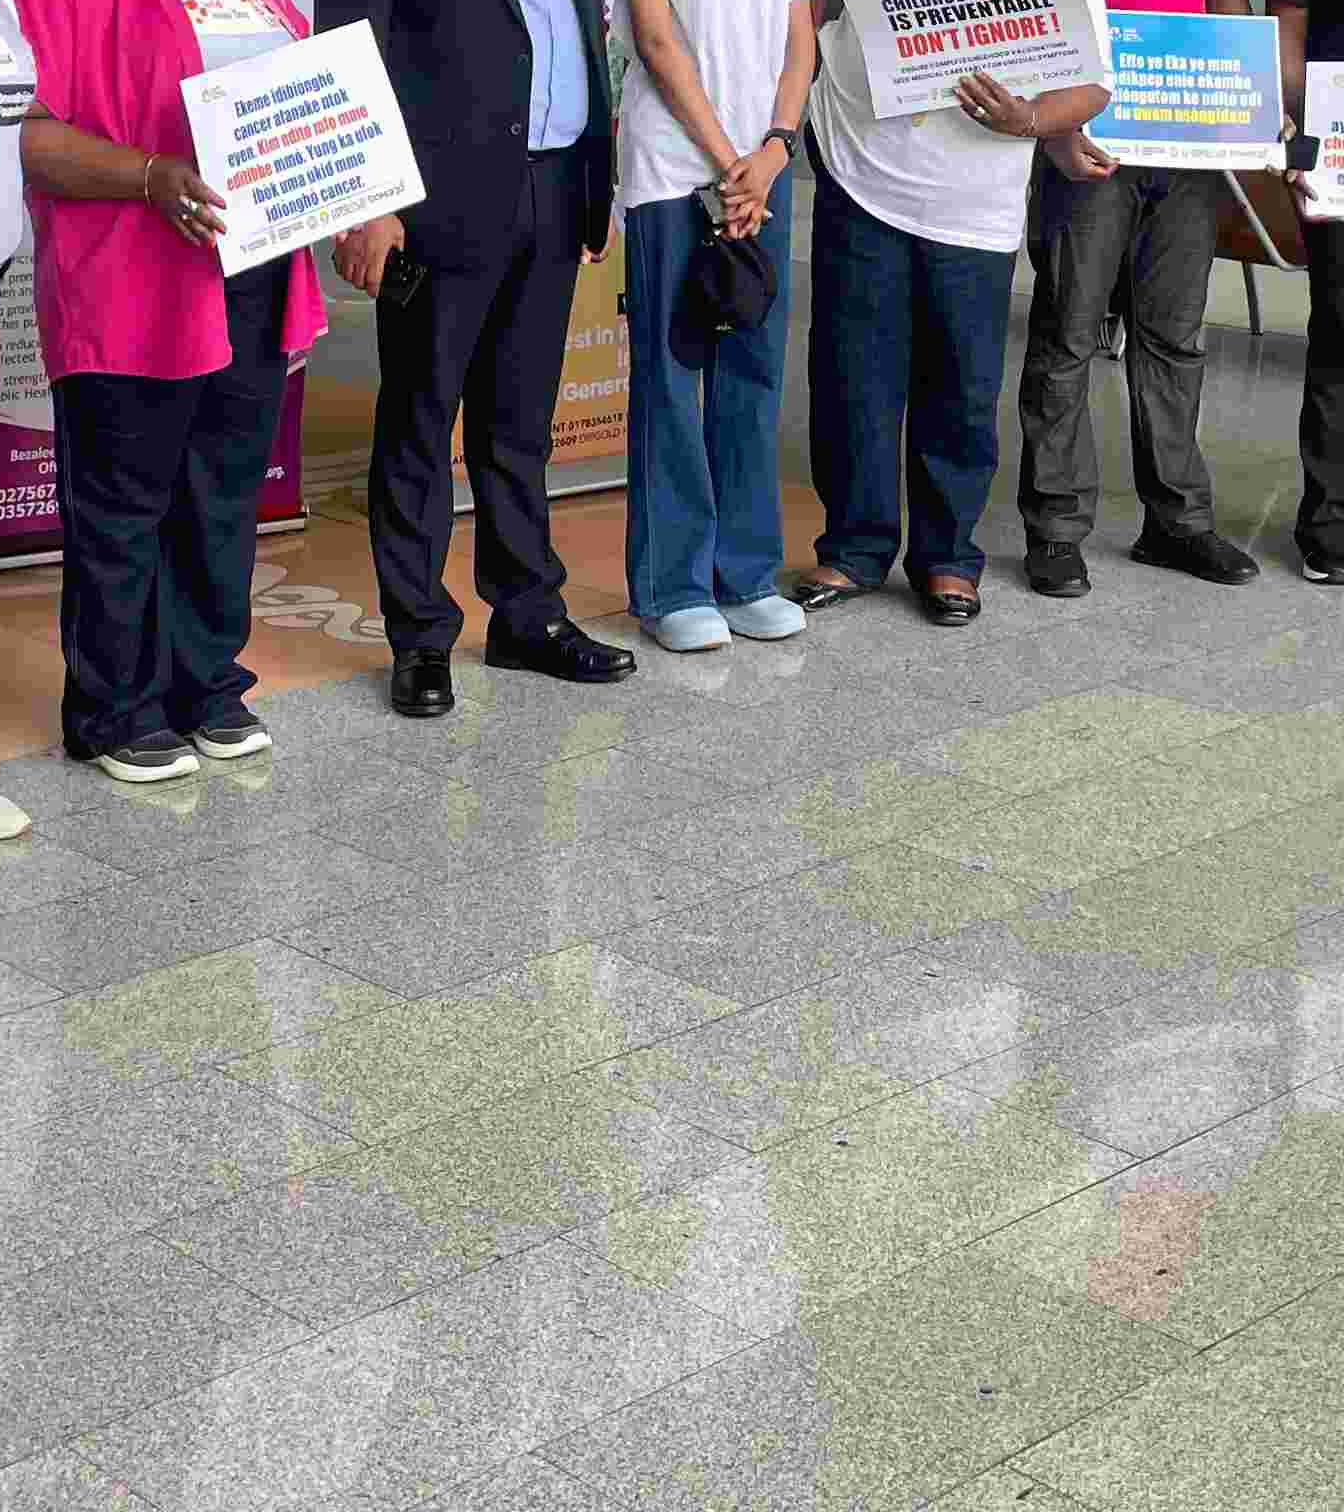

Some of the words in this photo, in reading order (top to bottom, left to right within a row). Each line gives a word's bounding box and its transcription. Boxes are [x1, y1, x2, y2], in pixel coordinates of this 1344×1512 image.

[888, 11, 913, 32] IS
[896, 28, 960, 58] DON'T
[966, 15, 1049, 48] IGNORE
[234, 117, 272, 141] cancer
[320, 88, 350, 109] ntok
